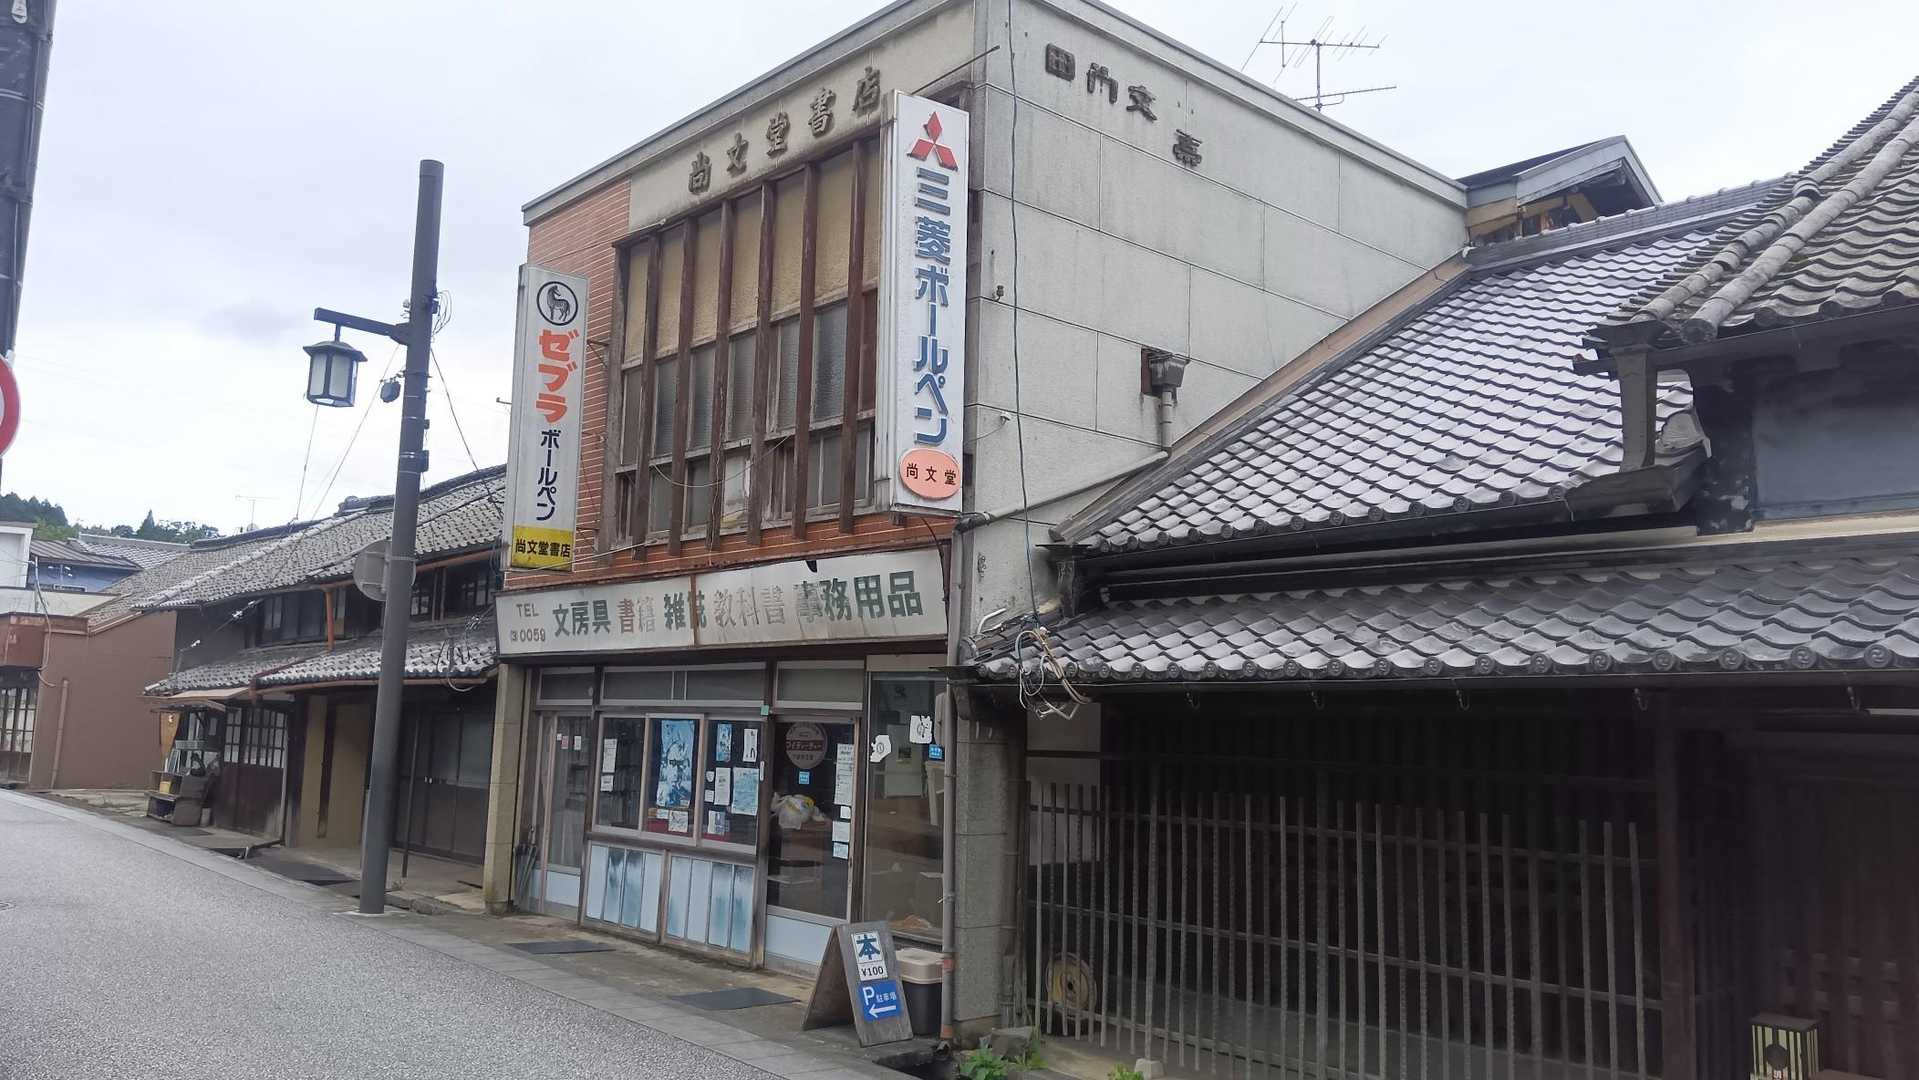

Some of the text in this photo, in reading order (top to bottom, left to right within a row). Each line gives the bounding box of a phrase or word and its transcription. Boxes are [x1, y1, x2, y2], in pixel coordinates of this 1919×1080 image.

[688, 66, 880, 195] 尚文堂書店
[914, 166, 952, 447] 三菱ボールペン
[535, 328, 580, 521] ゼブラ ボールペン
[905, 461, 957, 486] 尚文堂
[515, 538, 571, 558] 尚文堂書店
[516, 603, 539, 617] TEL
[552, 598, 611, 637] 文房具
[713, 584, 786, 627] 教科書
[793, 570, 924, 623] 事務用品
[856, 934, 880, 960] 本
[861, 966, 884, 976] ¥100
[862, 986, 875, 1006] P
